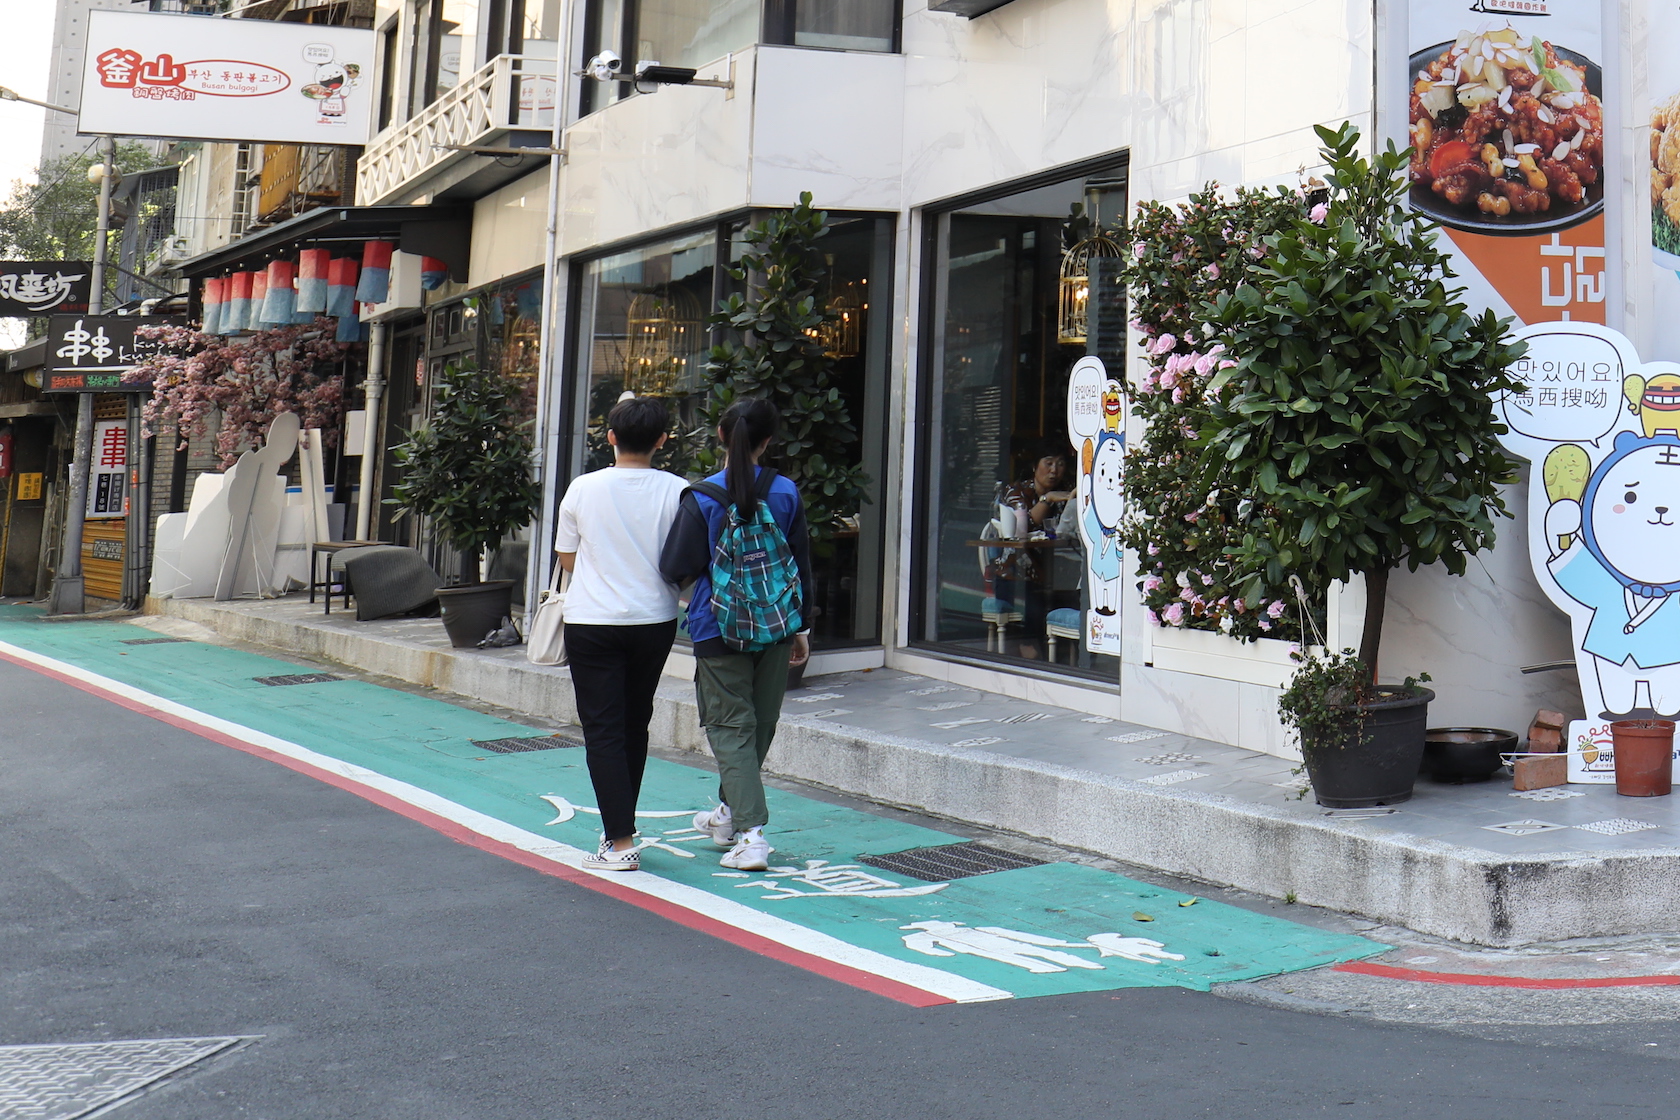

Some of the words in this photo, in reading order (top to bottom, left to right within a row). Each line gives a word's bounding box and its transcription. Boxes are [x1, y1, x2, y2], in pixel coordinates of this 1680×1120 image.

[97, 48, 186, 89] 釜山
[187, 68, 213, 81] 부산
[201, 81, 226, 91] Busan
[228, 83, 259, 93] bulgogi
